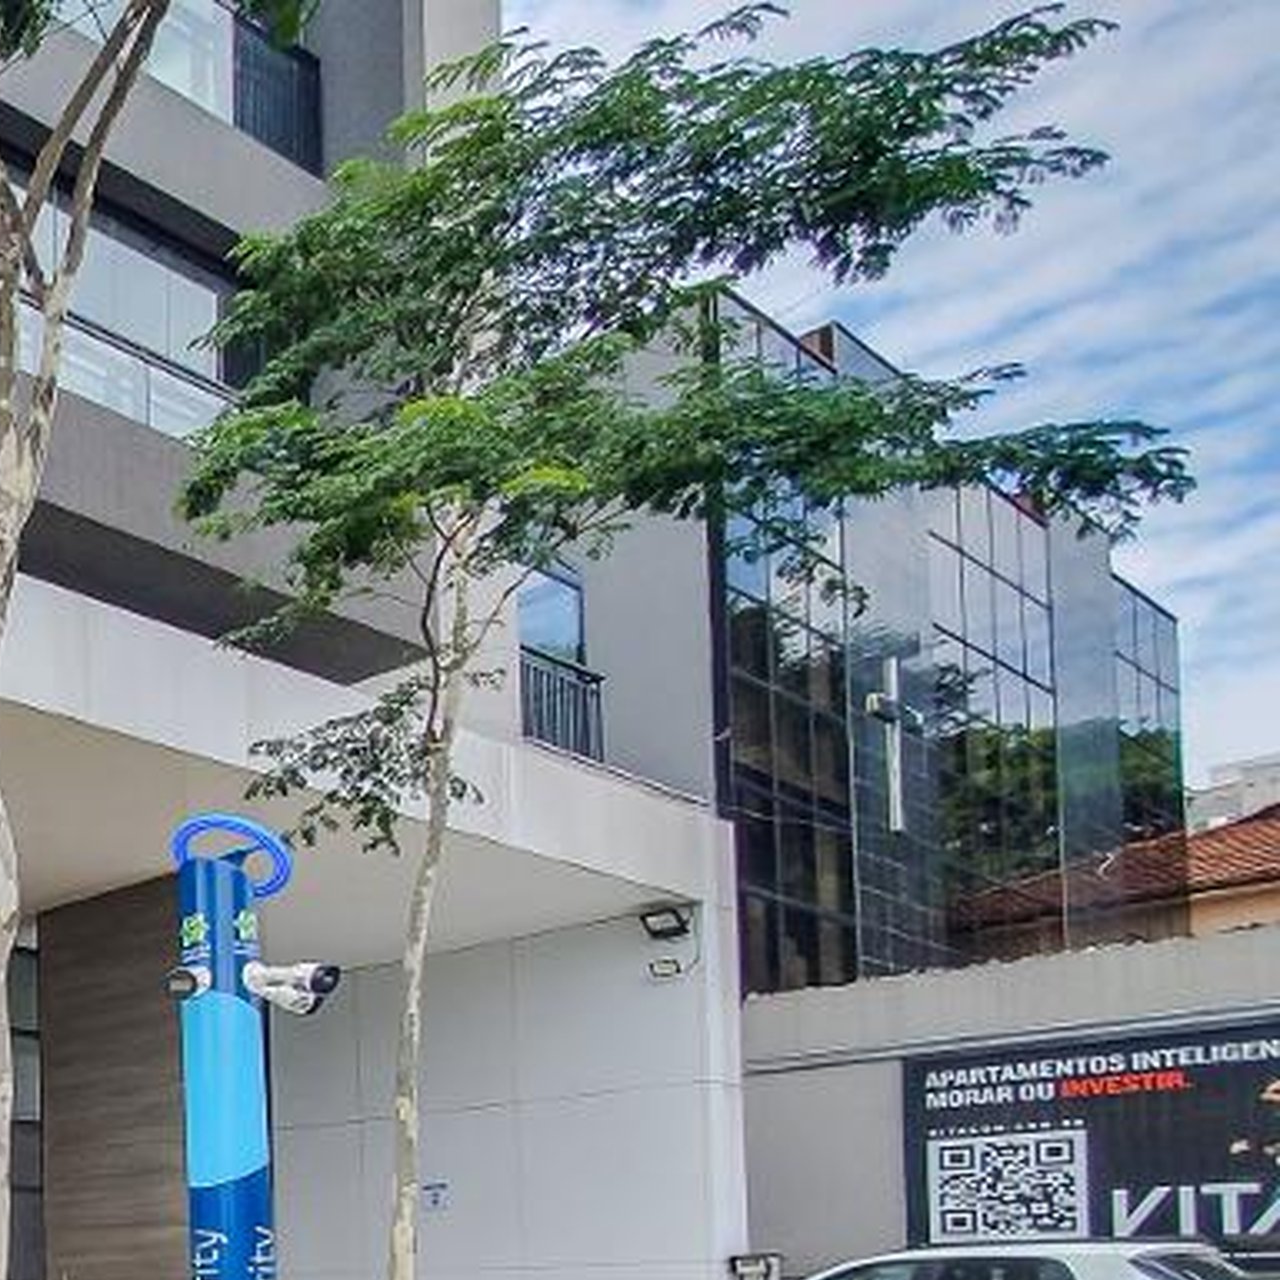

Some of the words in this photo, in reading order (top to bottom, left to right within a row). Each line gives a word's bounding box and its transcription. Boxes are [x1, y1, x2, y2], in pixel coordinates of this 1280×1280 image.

[926, 1053, 1126, 1089] APARTAMENTOS
[1131, 1039, 1280, 1071] INTELIGEN
[926, 1082, 1014, 1110] MORAR
[1018, 1082, 1055, 1102] OU
